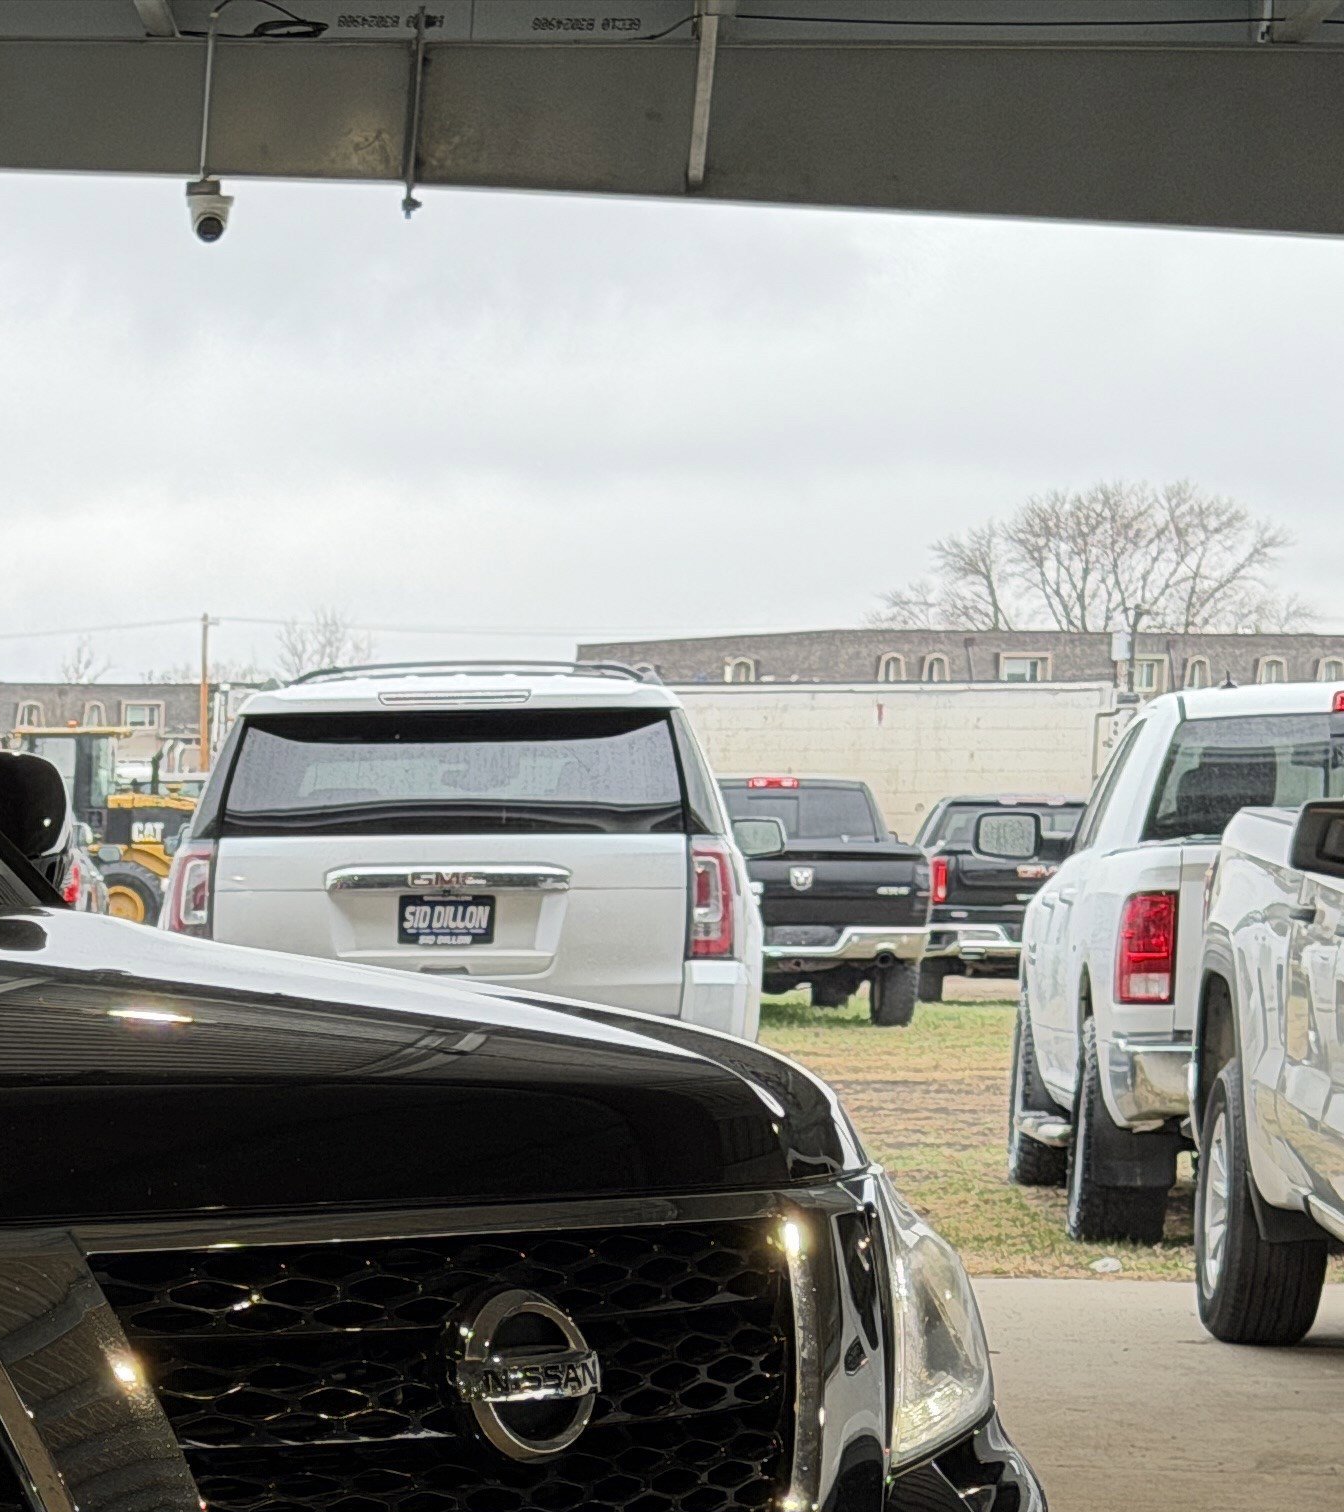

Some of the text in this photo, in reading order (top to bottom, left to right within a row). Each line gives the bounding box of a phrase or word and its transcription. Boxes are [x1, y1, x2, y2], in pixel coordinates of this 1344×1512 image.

[131, 821, 165, 843] CAT
[408, 872, 487, 888] GMC
[403, 905, 491, 929] SID DILLON
[482, 1362, 598, 1395] NISSAN
